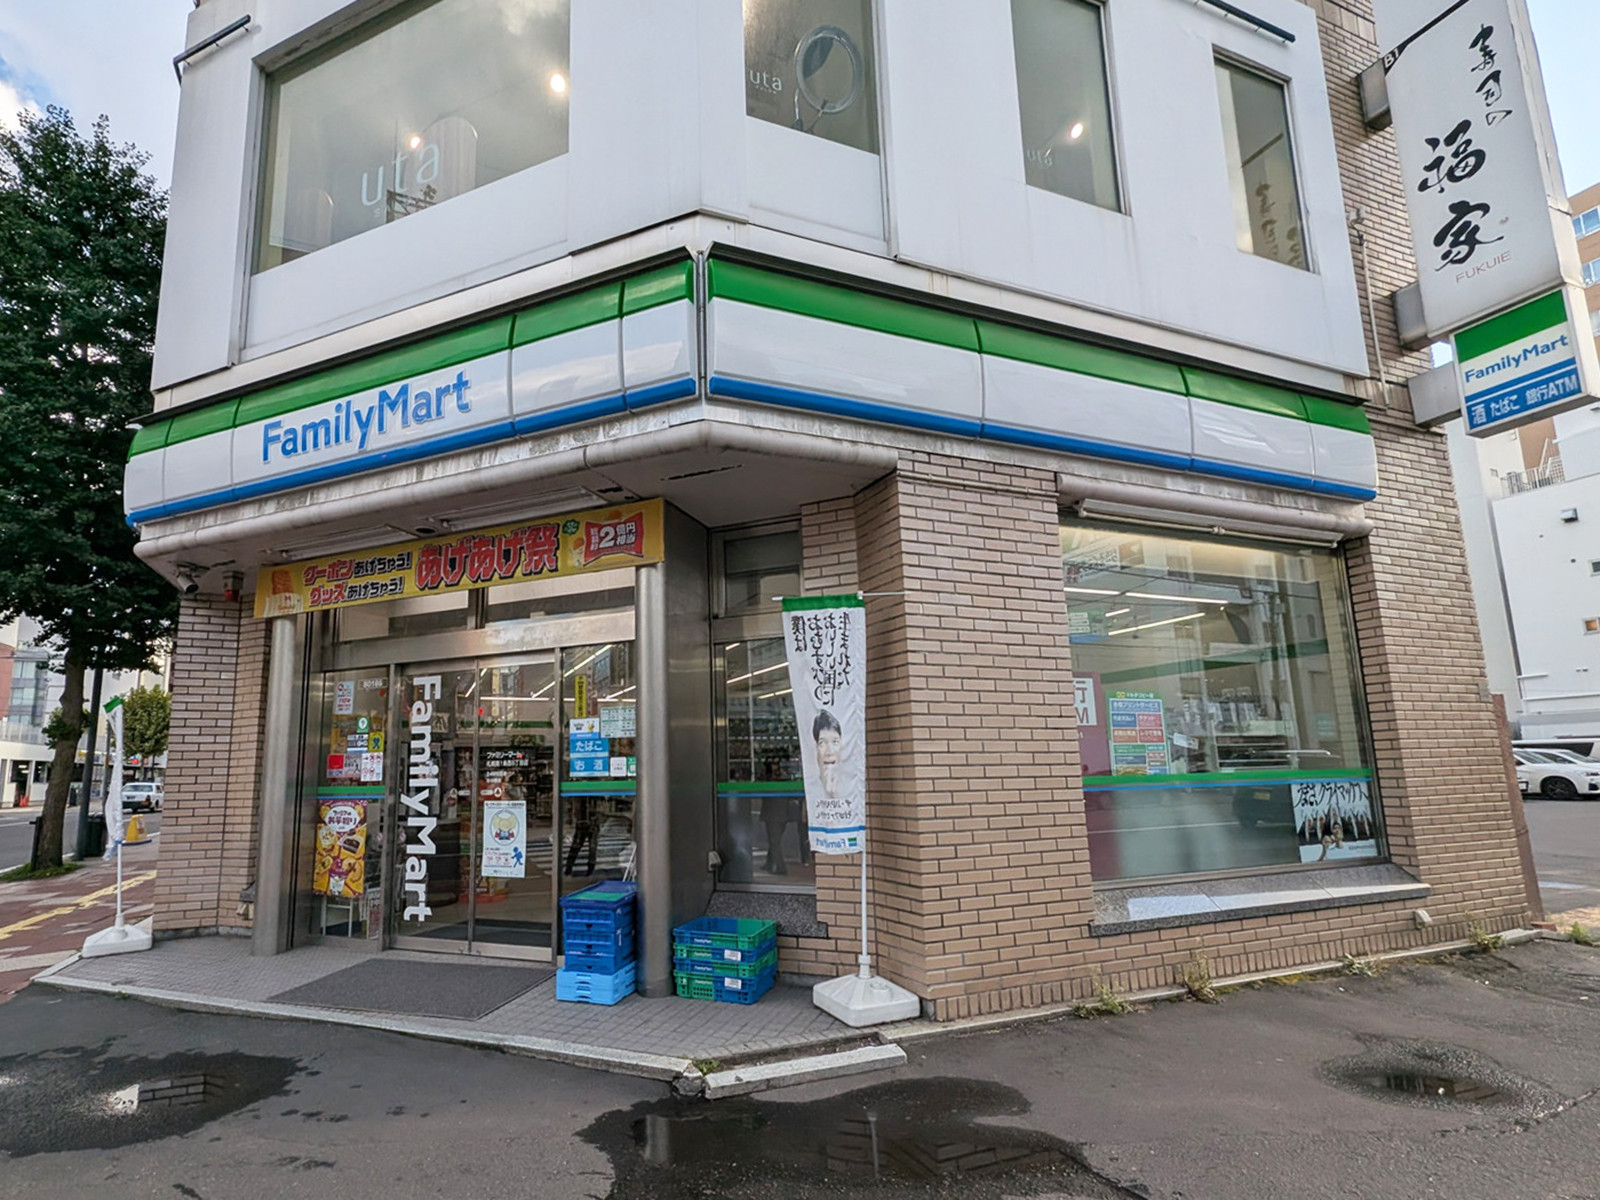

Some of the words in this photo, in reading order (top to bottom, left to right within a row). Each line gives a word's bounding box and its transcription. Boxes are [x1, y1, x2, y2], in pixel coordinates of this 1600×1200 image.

[750, 70, 782, 92] uta
[1384, 51, 1400, 69] B1
[1468, 23, 1513, 127] 寿司の
[362, 143, 441, 207] uta
[1417, 119, 1505, 272] 福家
[1455, 251, 1512, 284] FUKUIE
[1464, 334, 1569, 383] FamilyMart
[262, 370, 471, 463] FamilyMart
[1471, 403, 1487, 425] 酒
[1489, 394, 1521, 418] たばこ
[1525, 374, 1579, 406] 銀行ATM
[415, 523, 561, 591] あげあげ祭
[576, 741, 603, 752] たばこ
[400, 674, 442, 922] FamilyMart
